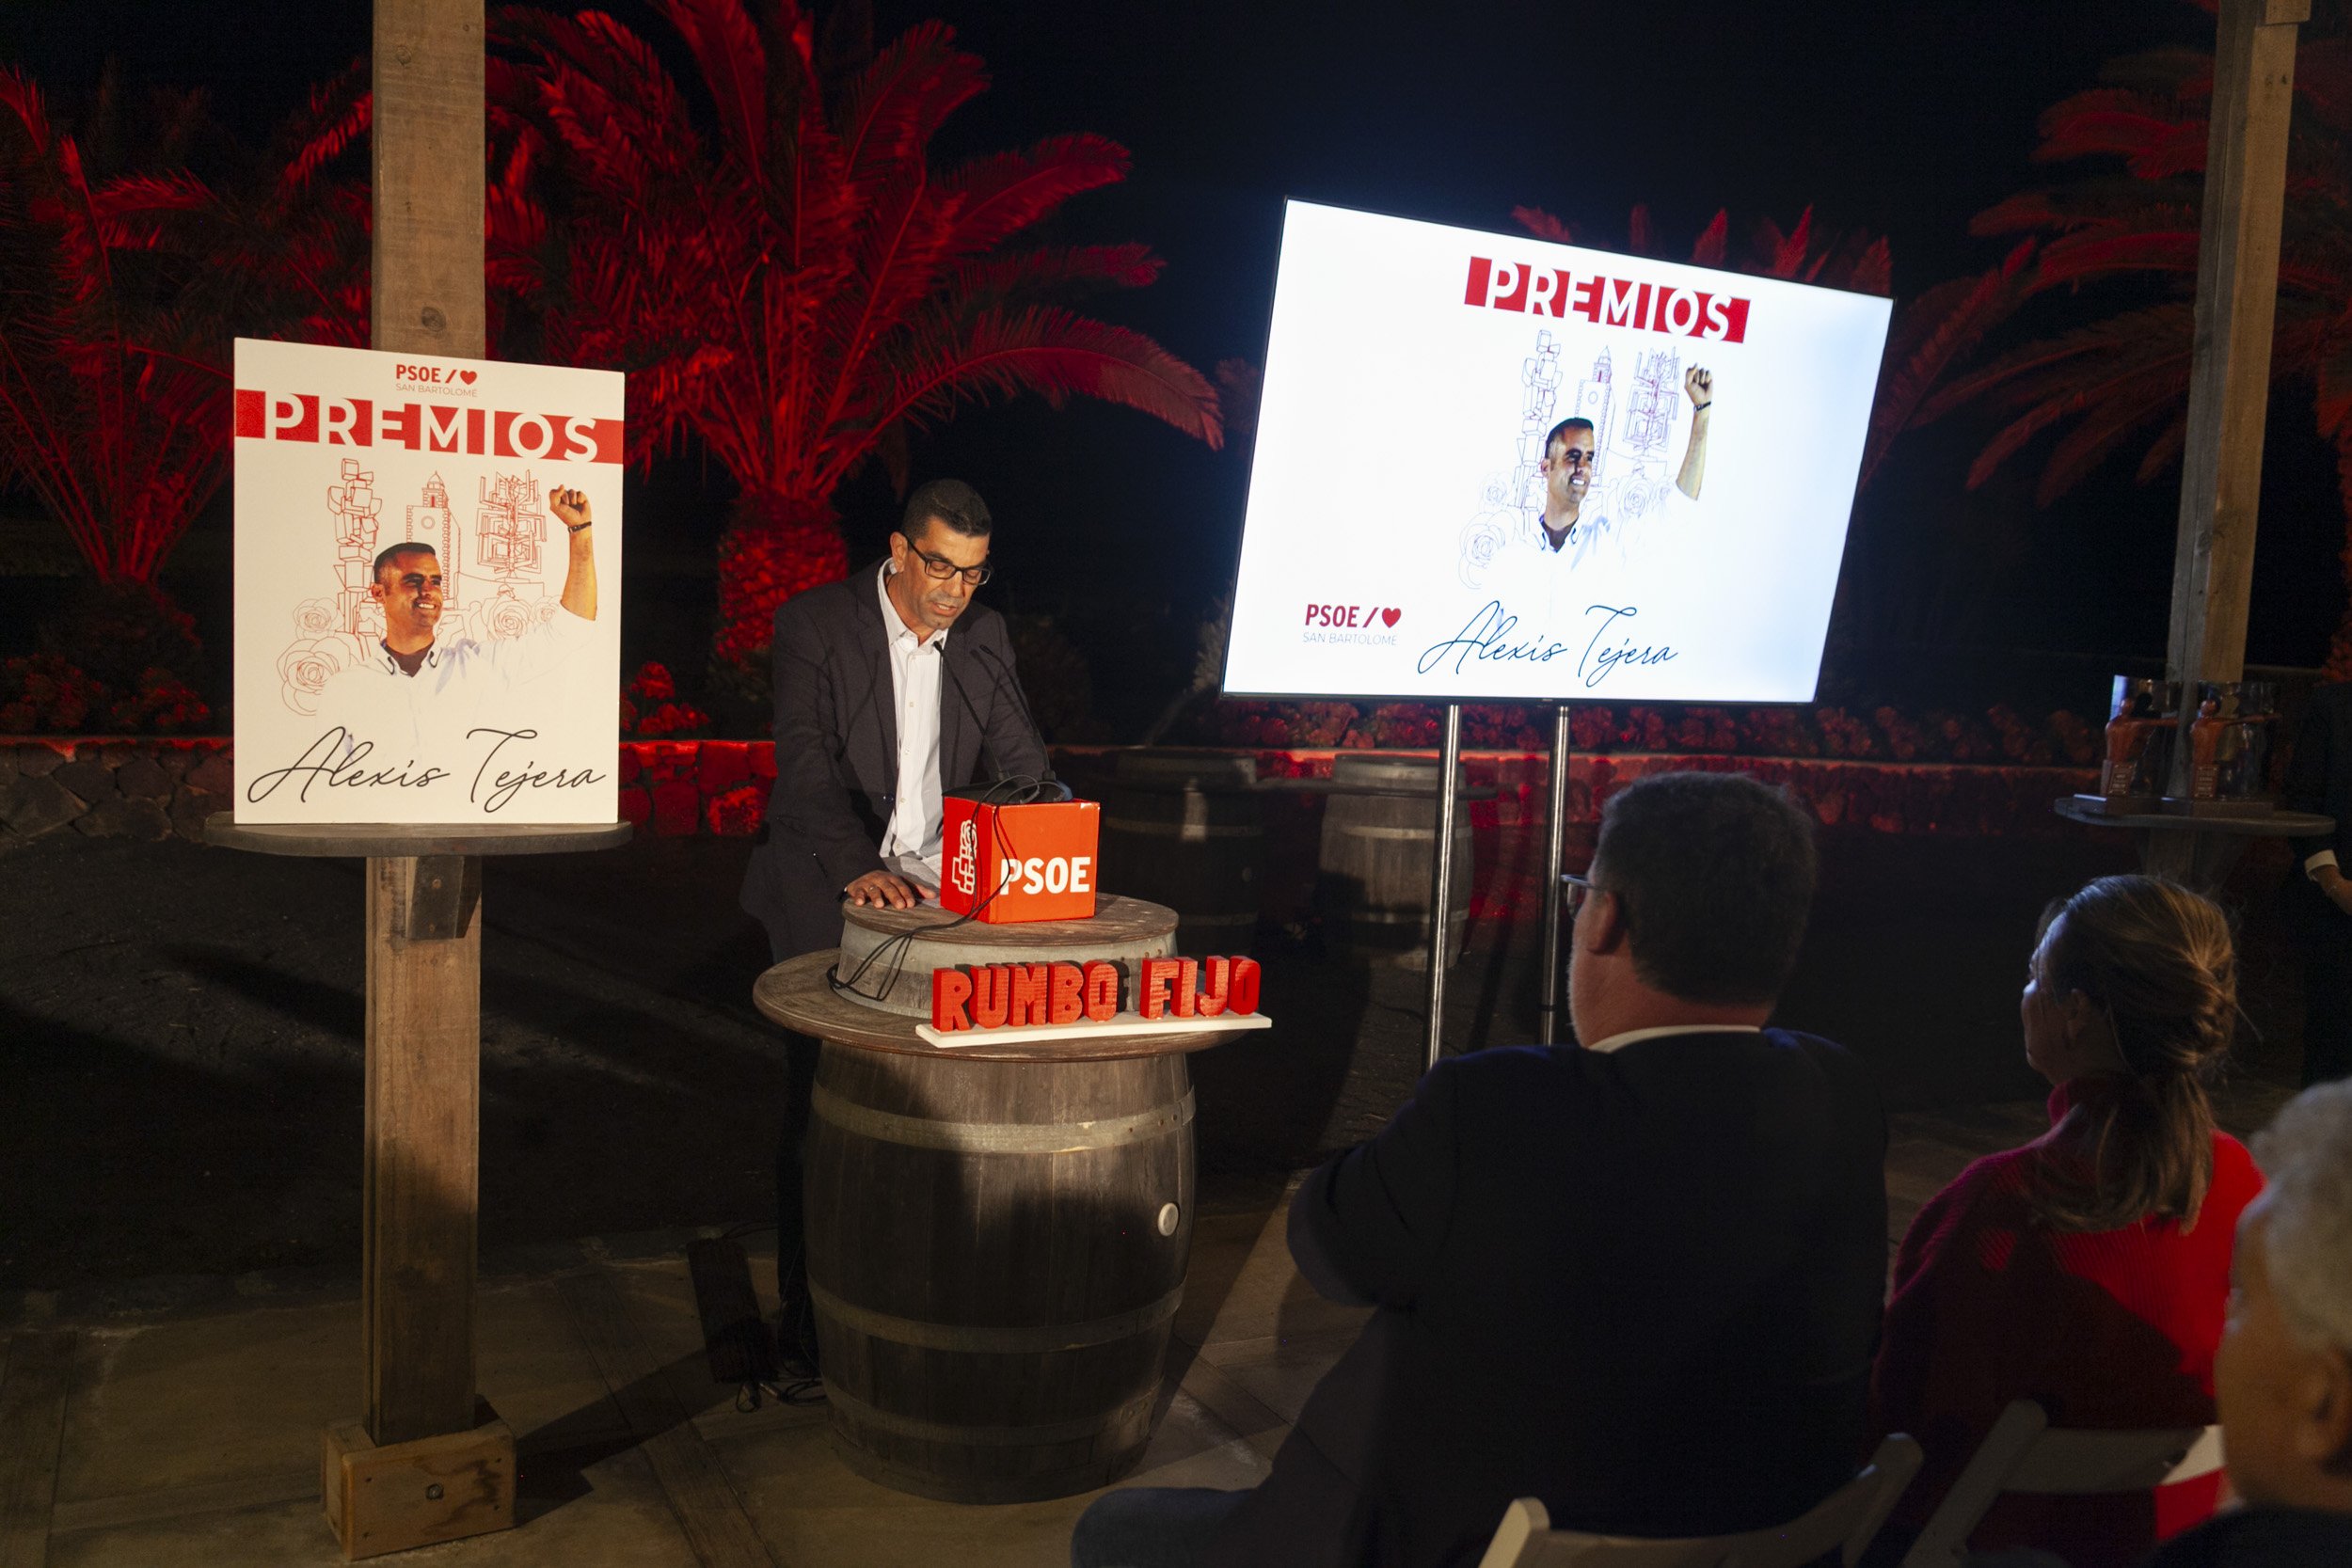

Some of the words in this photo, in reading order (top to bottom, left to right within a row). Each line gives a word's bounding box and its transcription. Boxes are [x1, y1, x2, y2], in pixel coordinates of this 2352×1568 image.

[1485, 260, 1731, 342] PREMIOS
[396, 364, 440, 383] PSOE
[396, 383, 415, 391] SAN
[265, 392, 597, 463] PREMIOS
[1303, 632, 1326, 643] SAN
[1305, 604, 1360, 628] PSOE
[1417, 600, 1568, 674] Alexis
[1577, 604, 1679, 689] Tejera
[247, 726, 451, 804] Alexis
[466, 728, 606, 814] Tejera
[999, 856, 1091, 895] PSOE
[931, 959, 1119, 1033] RUMBO
[1139, 954, 1262, 1021] FIJO
